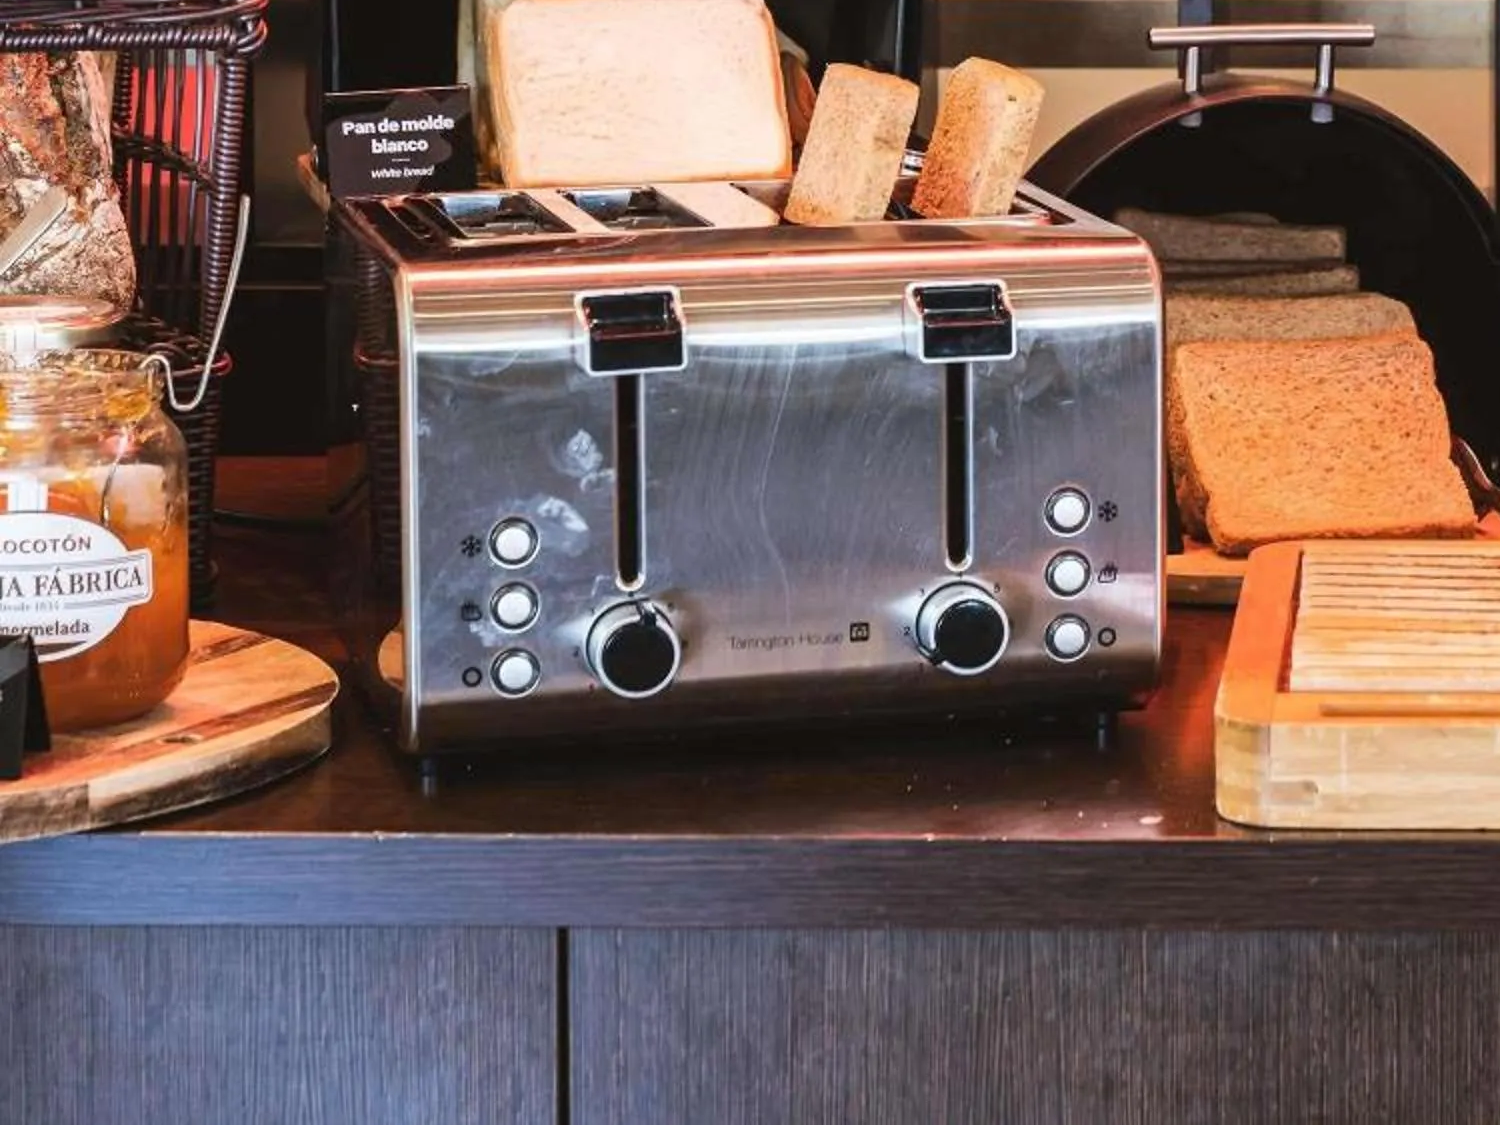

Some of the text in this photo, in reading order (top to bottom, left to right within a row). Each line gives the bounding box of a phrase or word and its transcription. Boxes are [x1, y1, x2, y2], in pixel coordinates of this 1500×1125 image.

[342, 114, 455, 135] Pan de molde
[371, 138, 429, 154] blanco
[371, 164, 435, 178] White bread
[35, 566, 143, 597] FÁBRICA
